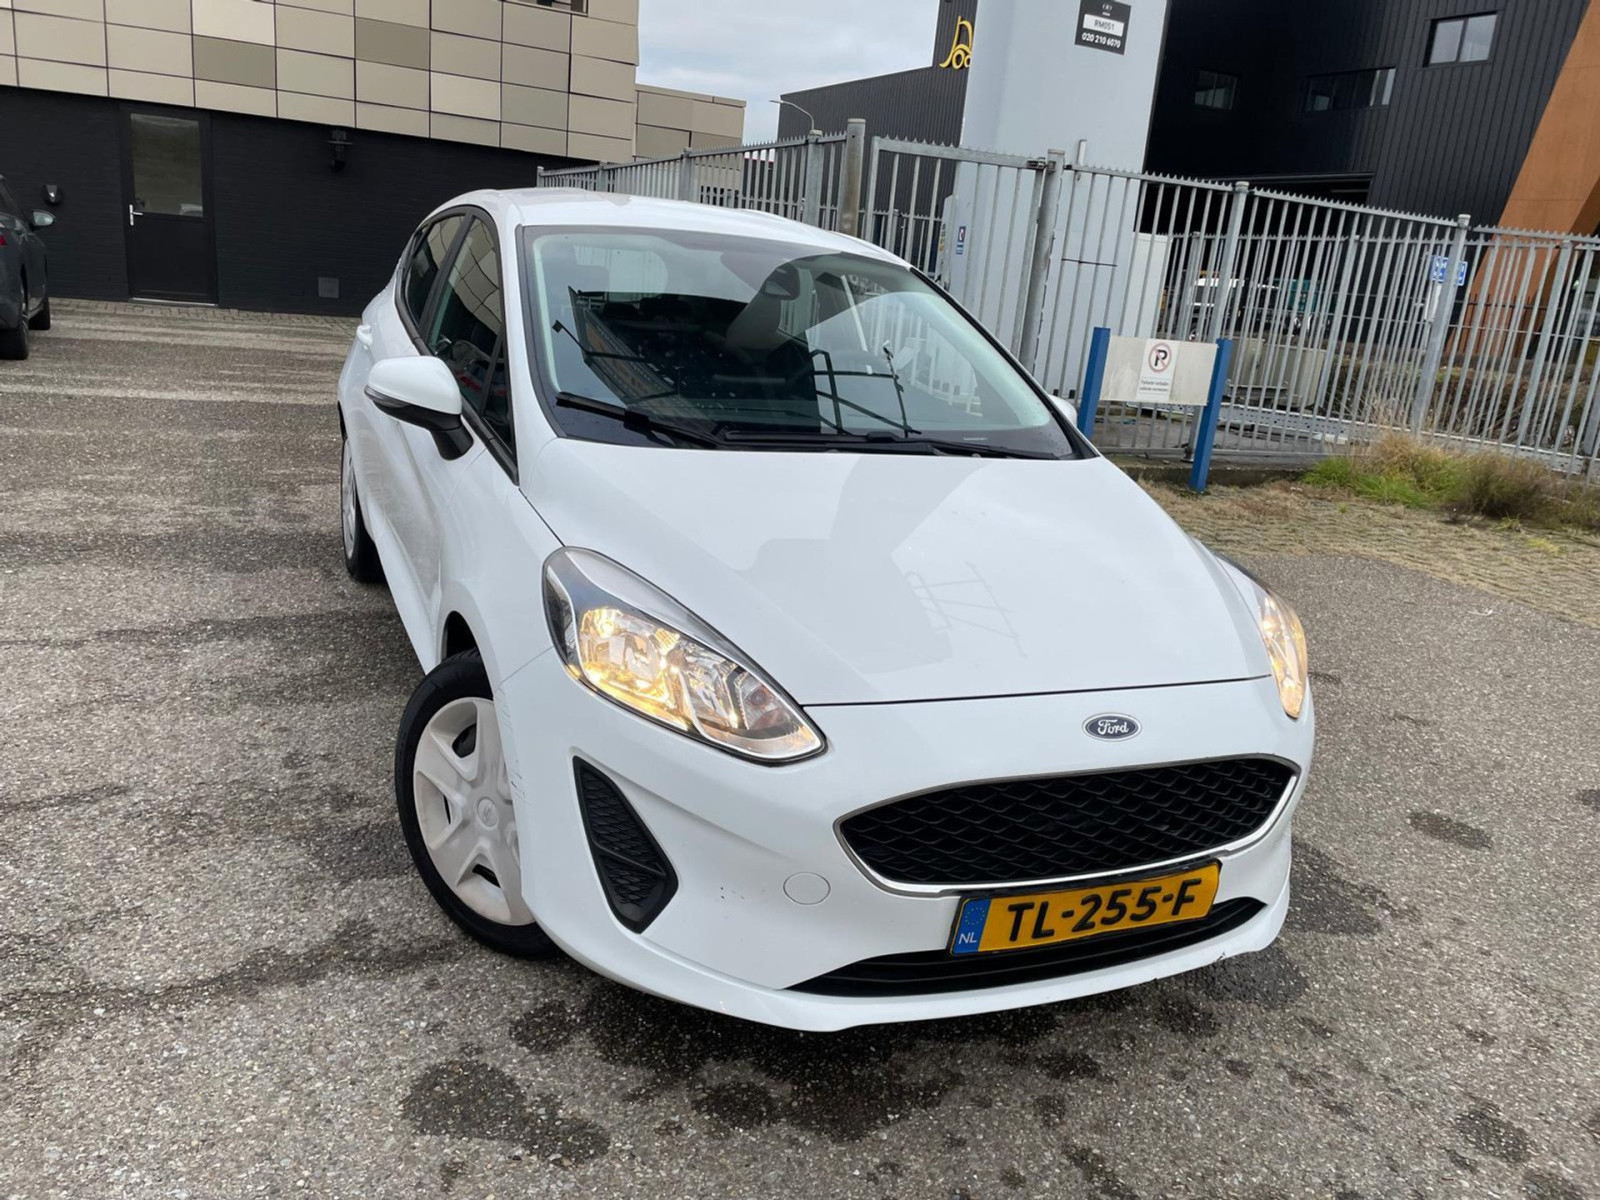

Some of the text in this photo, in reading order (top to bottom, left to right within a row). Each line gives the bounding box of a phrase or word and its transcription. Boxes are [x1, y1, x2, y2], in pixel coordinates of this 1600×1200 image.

[1082, 32, 1121, 48] 020 210 6070
[1097, 719, 1129, 735] Ford
[1008, 878, 1202, 941] TL-255-F
[958, 932, 977, 944] NL
